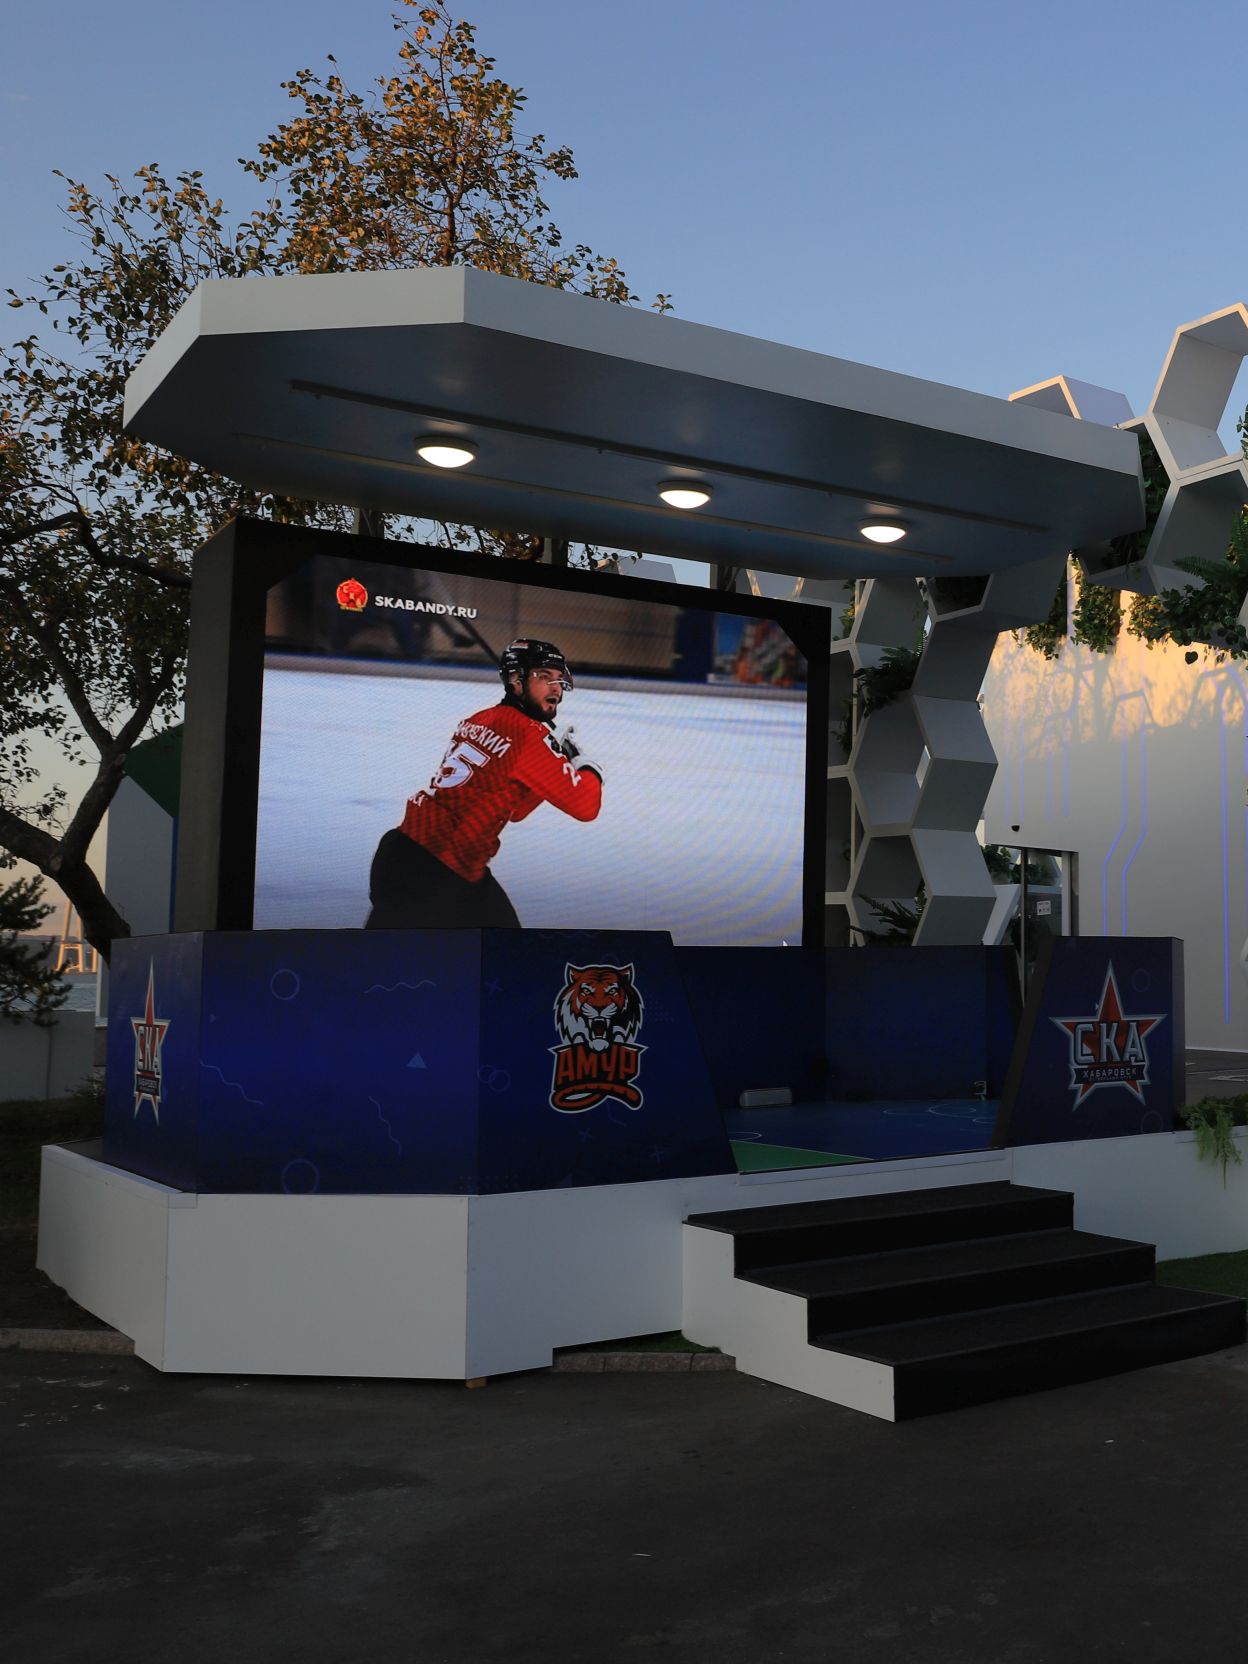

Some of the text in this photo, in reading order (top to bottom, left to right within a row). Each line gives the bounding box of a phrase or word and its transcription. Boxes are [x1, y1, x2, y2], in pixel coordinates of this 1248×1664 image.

[375, 595, 477, 619] SKABANDY.RU
[1074, 1021, 1145, 1064] СКА
[556, 1044, 638, 1086] АМУР
[1082, 1067, 1137, 1080] ХАБАРОВСК
